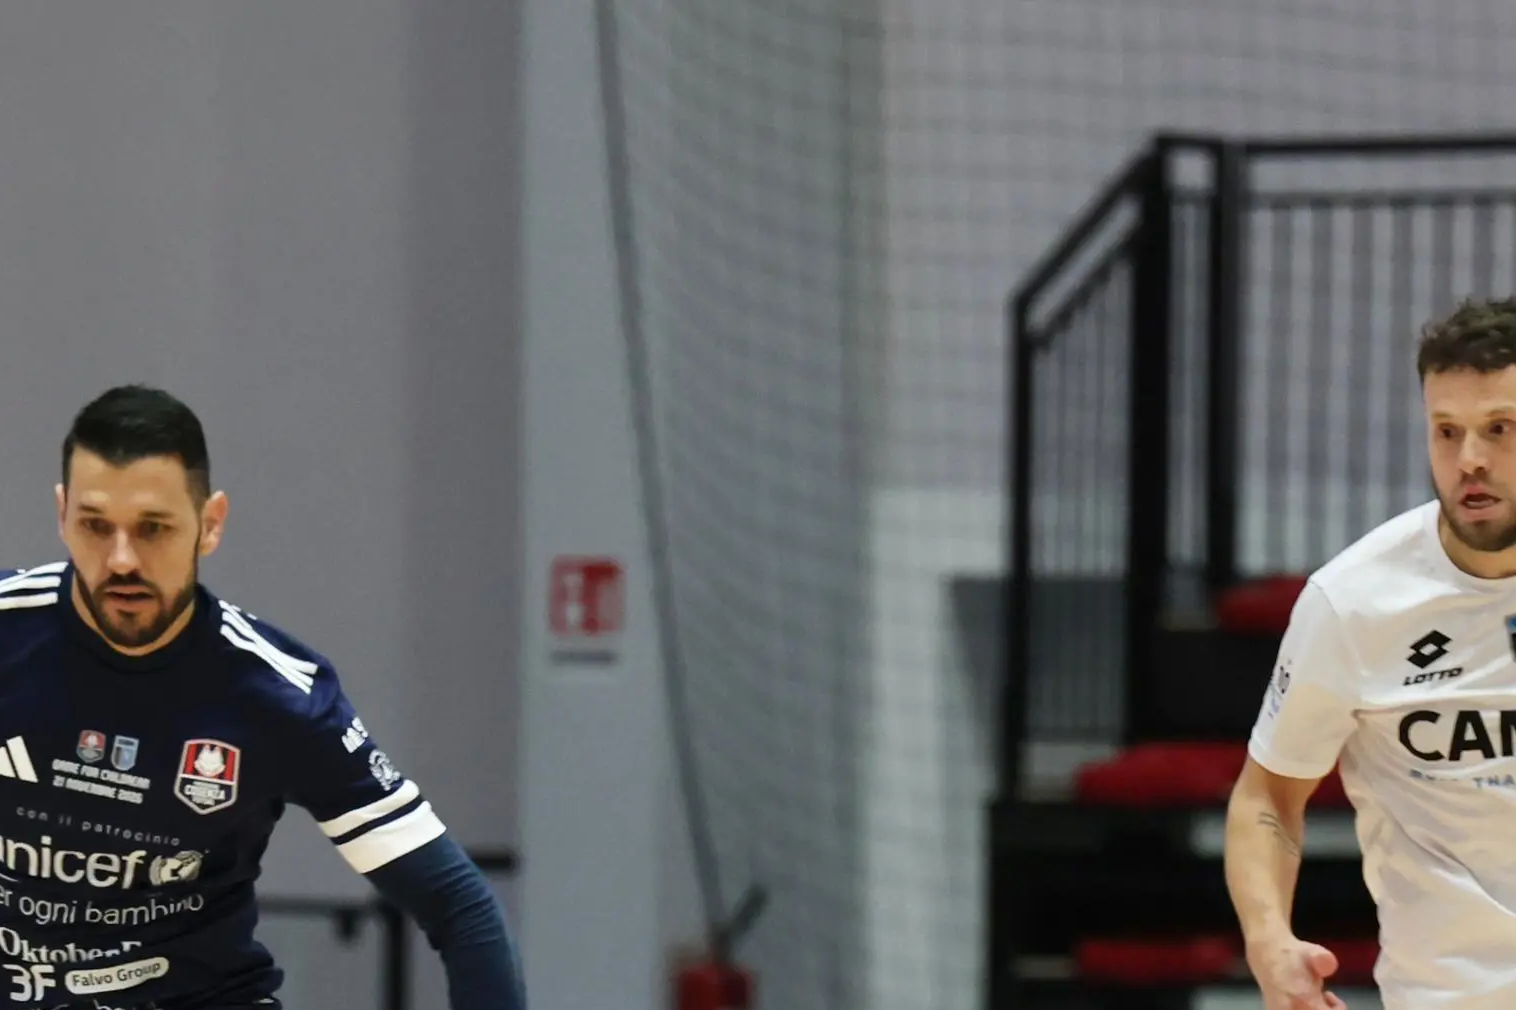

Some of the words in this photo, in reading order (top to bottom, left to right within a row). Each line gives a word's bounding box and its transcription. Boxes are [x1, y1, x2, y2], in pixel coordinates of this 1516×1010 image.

[1402, 667, 1464, 687] LOTTO
[16, 806, 49, 822] con
[81, 820, 181, 847] patrocinio
[19, 895, 79, 926] ogni
[71, 972, 113, 988] Falvo
[116, 961, 163, 983] Group
